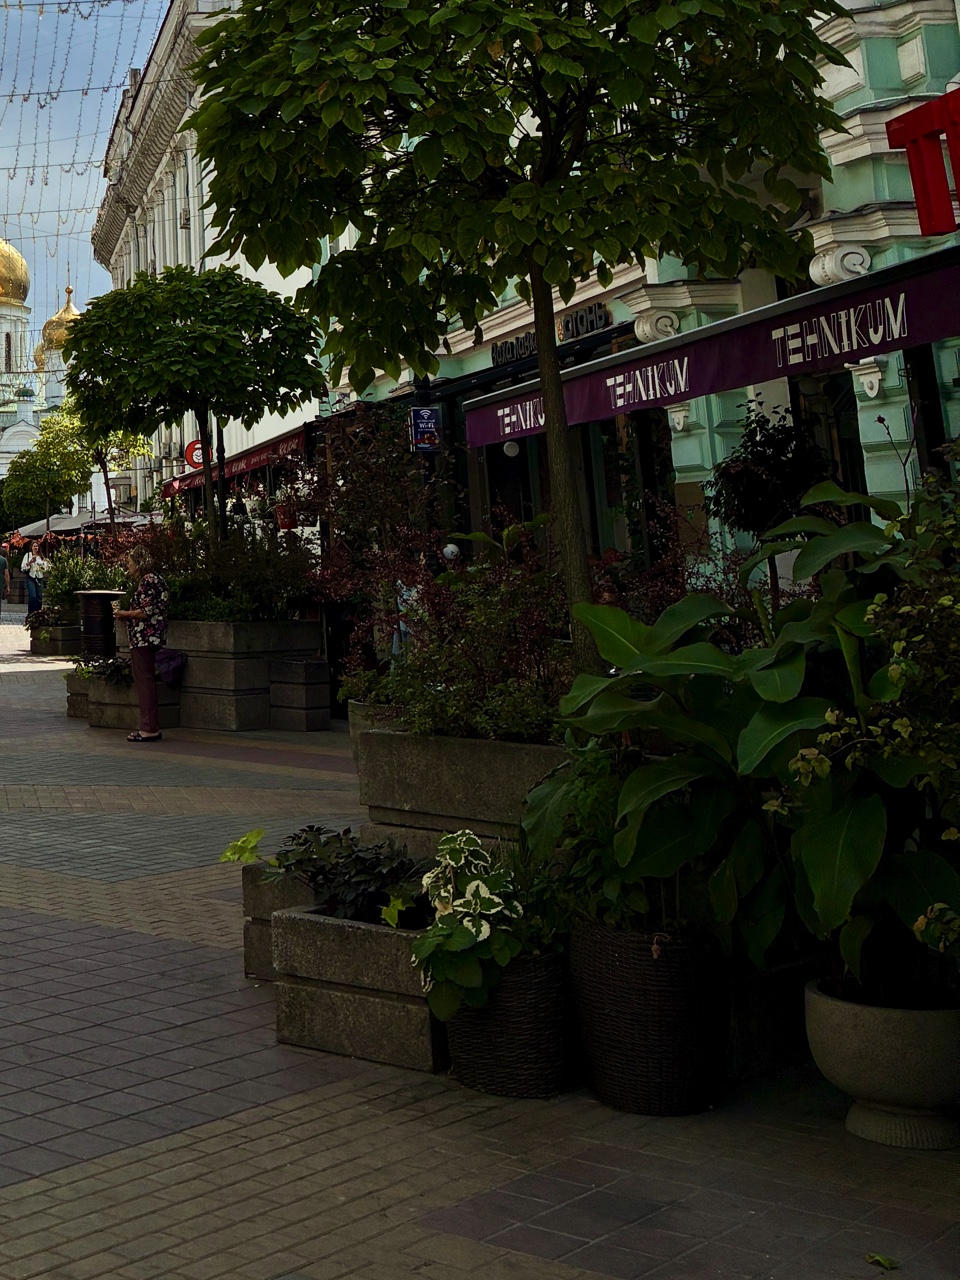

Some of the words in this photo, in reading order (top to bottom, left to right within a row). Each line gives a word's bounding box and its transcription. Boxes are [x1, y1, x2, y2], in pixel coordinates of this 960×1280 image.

[771, 292, 908, 368] TEHNIKUM
[606, 356, 690, 409] TEHNIKUM
[497, 397, 546, 435] TEHNIKU
